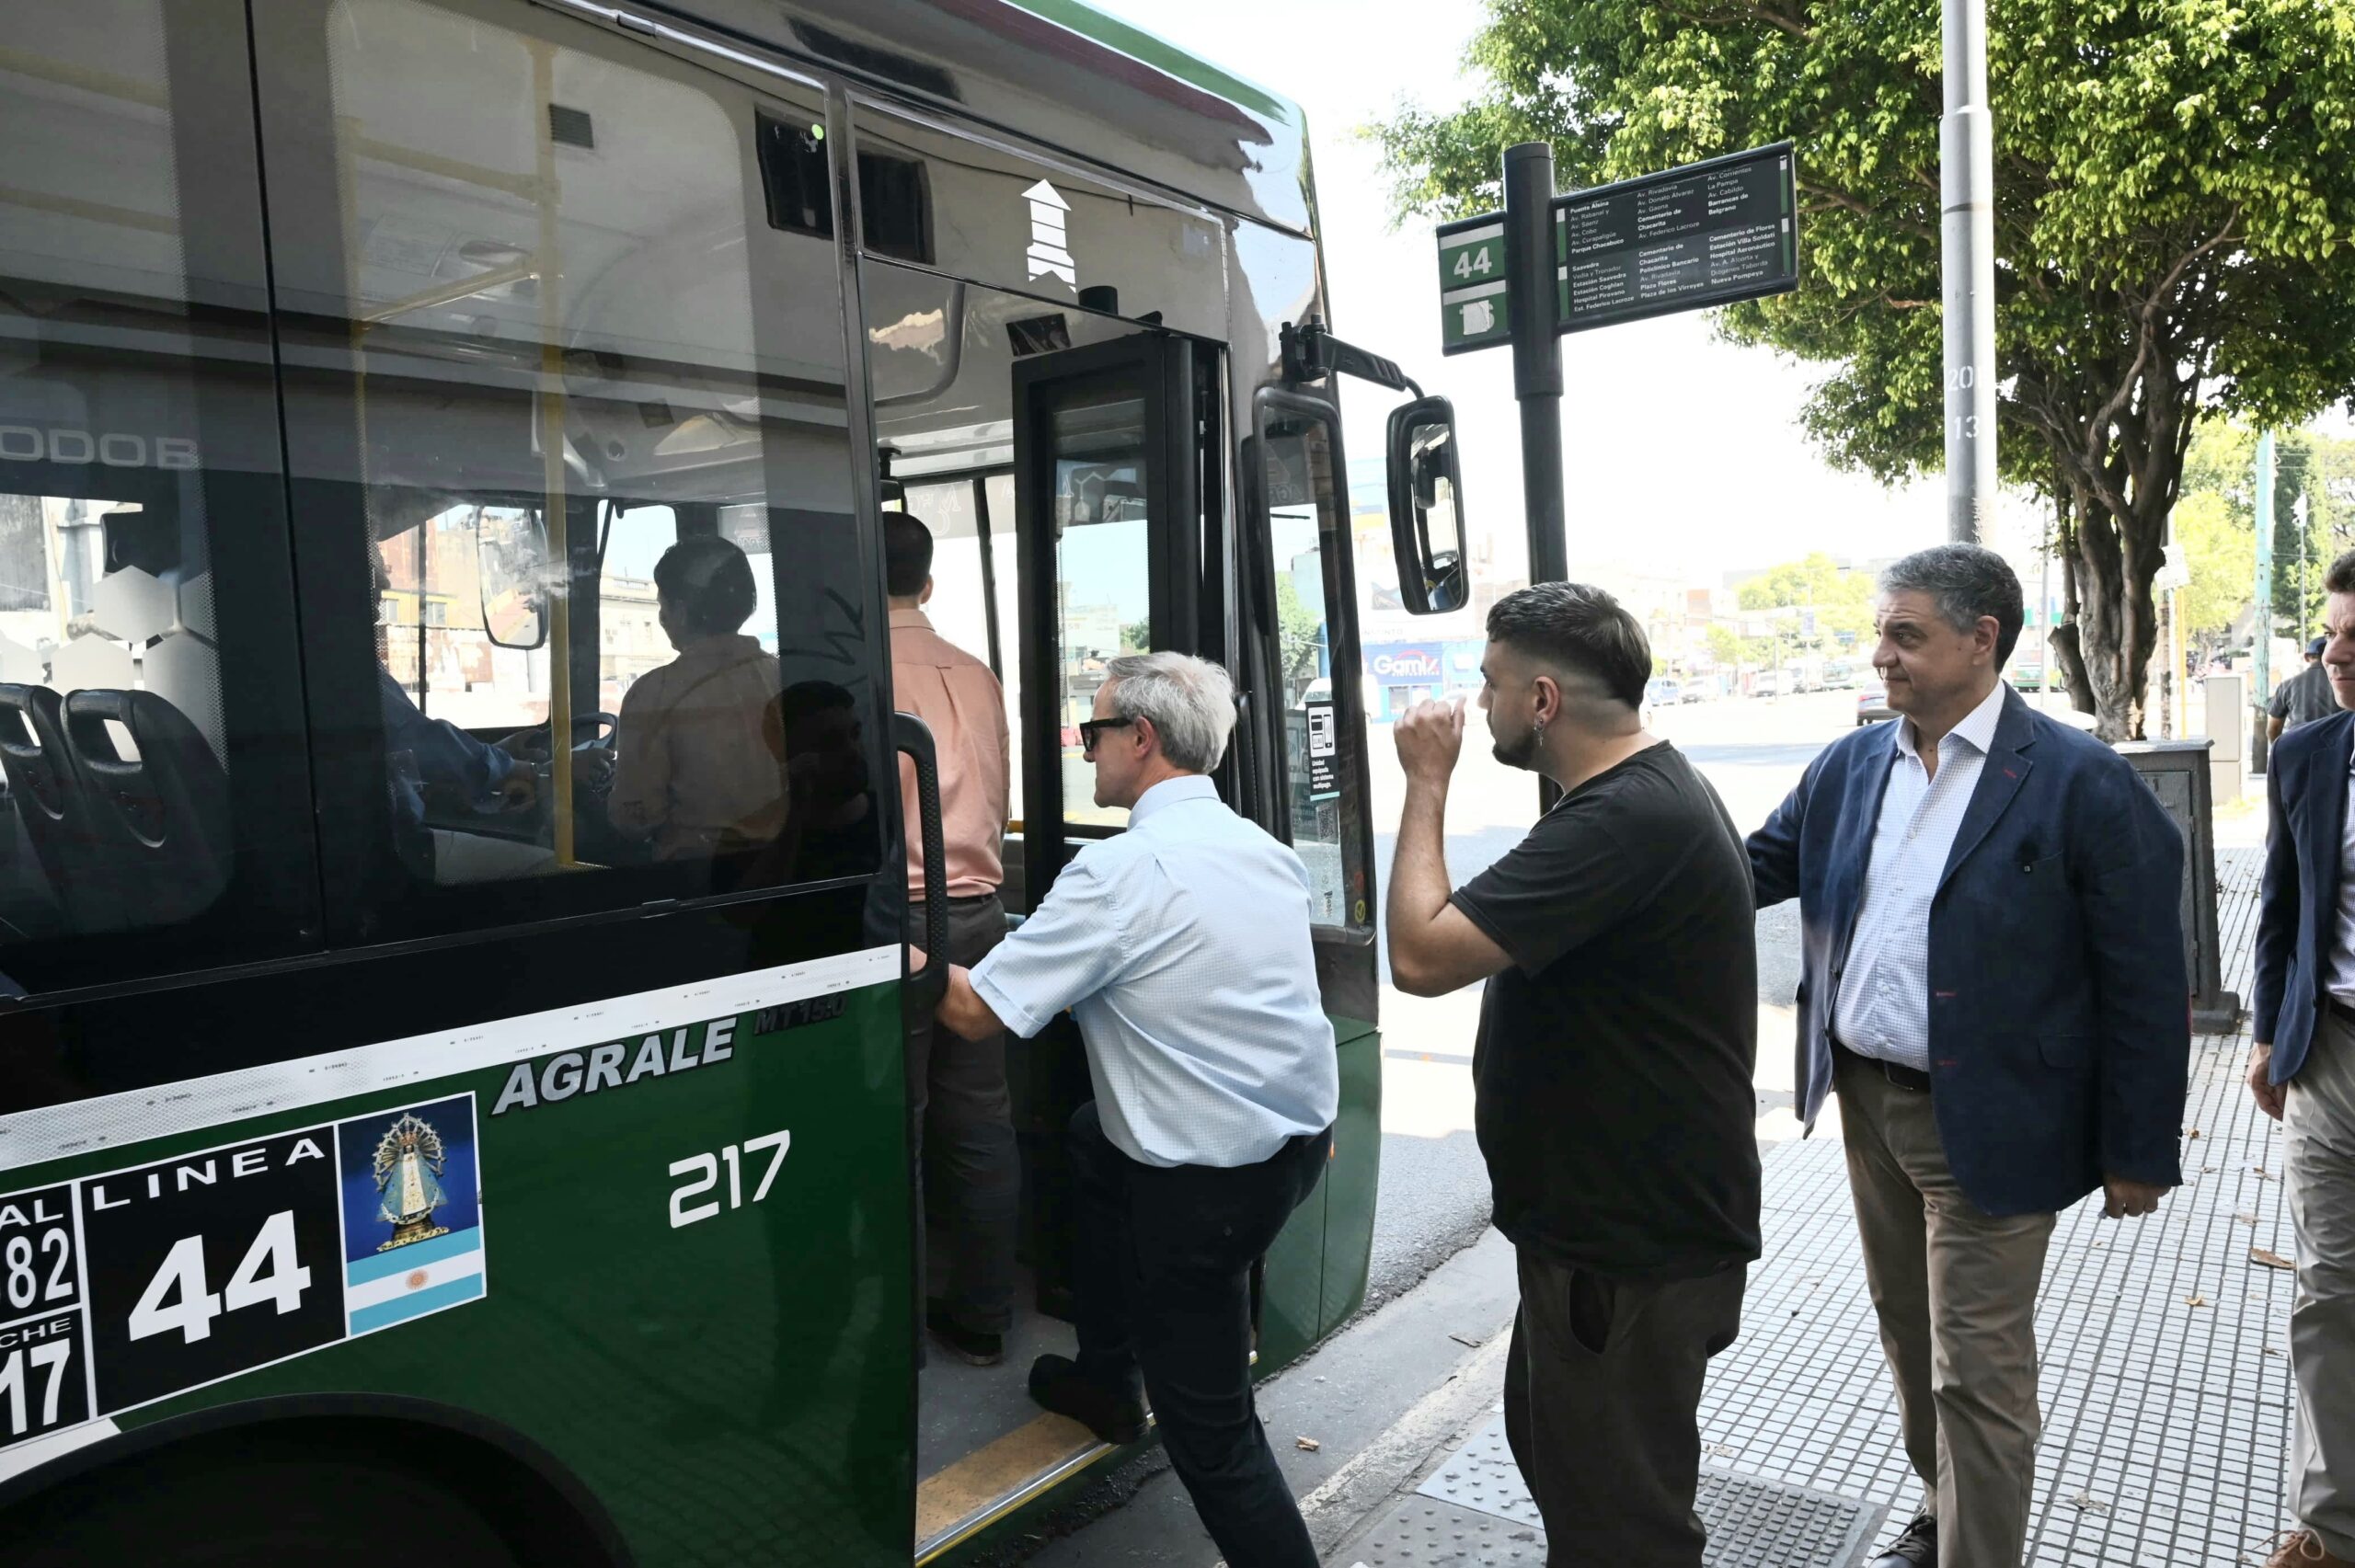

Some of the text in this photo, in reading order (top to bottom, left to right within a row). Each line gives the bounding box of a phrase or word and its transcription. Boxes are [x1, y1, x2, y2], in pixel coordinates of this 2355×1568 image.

[1718, 166, 1752, 179] Corrientes
[1717, 178, 1739, 189] Pampa
[1648, 185, 1678, 196] Rivadavia
[1719, 186, 1744, 197] Cabildo
[1648, 195, 1671, 204] Donato
[1707, 195, 1740, 208] Barrancas
[1570, 200, 1610, 213] Puente Alsina
[1648, 203, 1669, 212] Gaona
[1708, 204, 1737, 215] Belgrano
[1581, 210, 1604, 220] Rabanal
[1637, 211, 1672, 223] Cementerio
[1637, 220, 1667, 231] Chacarita
[1649, 227, 1675, 237] Federico
[1676, 221, 1700, 232] Lacroze
[1709, 230, 1746, 243] Cementerio
[1755, 223, 1775, 233] Flores
[1571, 237, 1625, 254] Parque Chacabuco
[1709, 241, 1736, 251] Estación
[1752, 232, 1775, 242] Soldati
[1709, 241, 1775, 259] Hospital Aeronáutico
[1453, 246, 1492, 279] 44
[1639, 256, 1669, 266] Chacarita
[1672, 257, 1700, 269] Bancario
[1730, 254, 1753, 263] Alcorta
[1741, 260, 1768, 269] Taborda
[1572, 262, 1600, 272] Saavedra
[1595, 265, 1621, 276] Tronador
[1573, 272, 1626, 289] Estación Saavedra
[1651, 269, 1682, 280] Rivadavia
[1733, 270, 1763, 281] Pompeya
[1573, 281, 1625, 296] Estación Coghlan
[1640, 291, 1658, 299] Plaza
[1678, 281, 1704, 292] Virreyes
[1658, 279, 1677, 288] Flores
[1574, 289, 1626, 305] Hospital Pirovano
[1586, 300, 1611, 310] Federico
[1612, 296, 1635, 305] Lacroze
[1953, 416, 1980, 441] 13
[489, 1016, 737, 1115] AGRALE
[93, 1138, 325, 1211] LINEA
[669, 1129, 790, 1229] 217
[0, 1199, 63, 1230] AL
[128, 1209, 312, 1345] 44
[0, 1337, 71, 1436] 17
